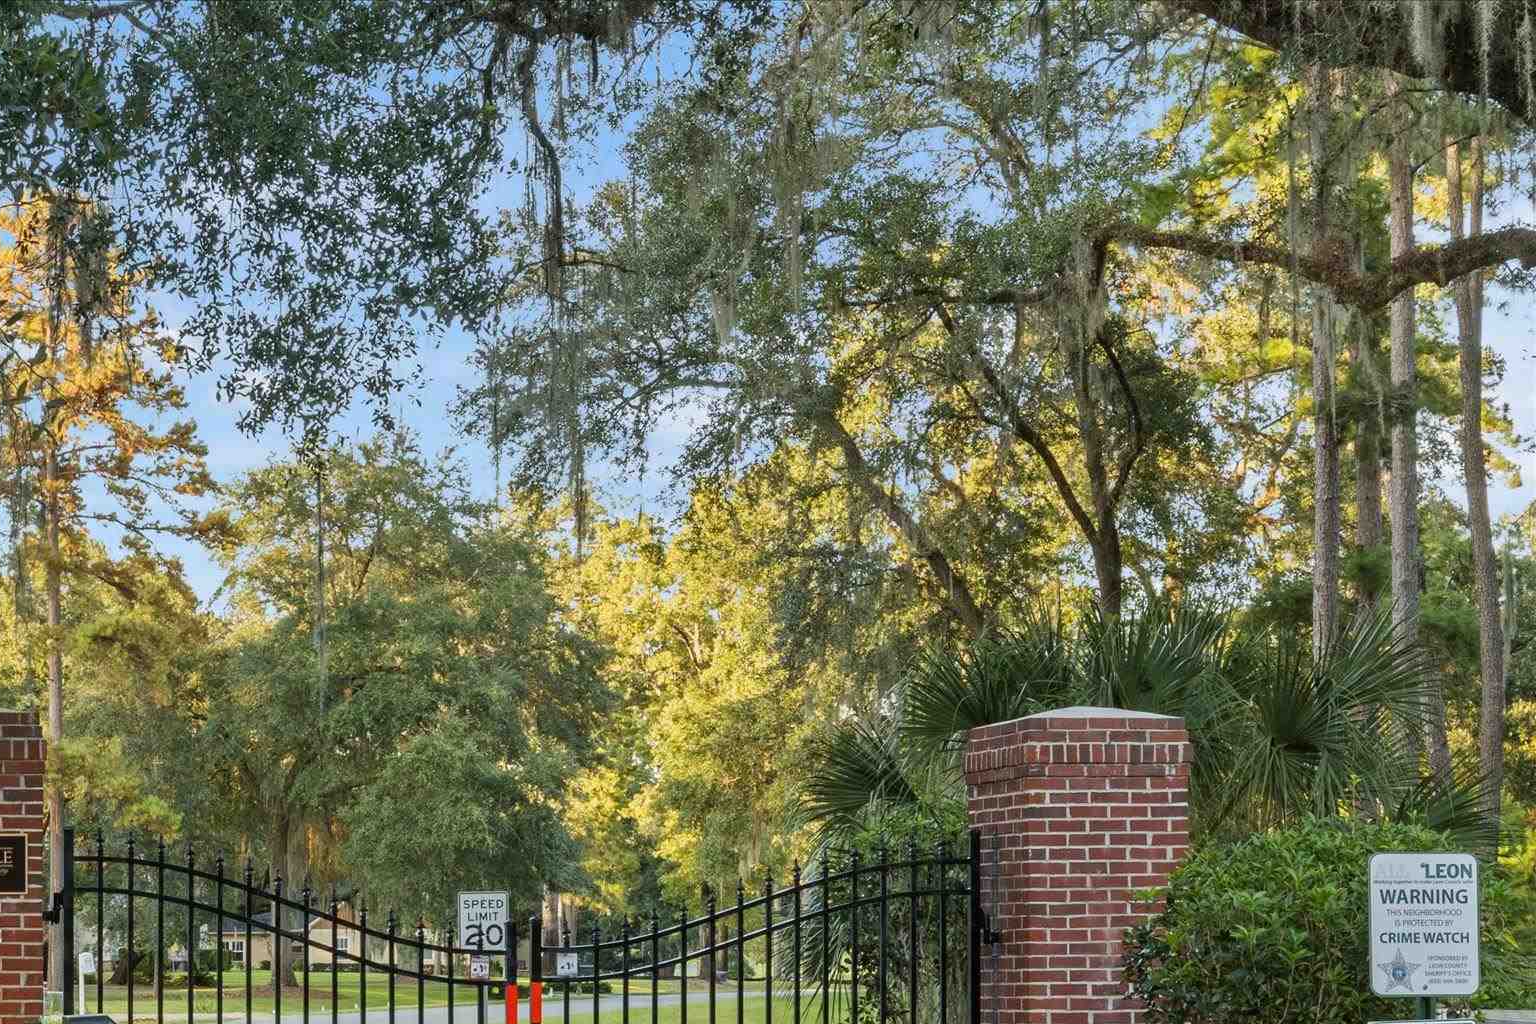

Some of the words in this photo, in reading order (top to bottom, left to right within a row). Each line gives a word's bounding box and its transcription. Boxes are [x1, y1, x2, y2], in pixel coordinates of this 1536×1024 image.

[1379, 888, 1468, 905] WARNING
[463, 899, 504, 910] SPEED
[467, 911, 499, 922] LIMIT
[1386, 908, 1402, 917] THIS
[1402, 908, 1463, 917] NEIGHBORHOOD
[1402, 919, 1444, 927] PROTECTED
[1444, 919, 1454, 927] BY
[464, 923, 504, 946] 20
[1379, 932, 1421, 944] CRIME
[1423, 932, 1470, 944] WATCH
